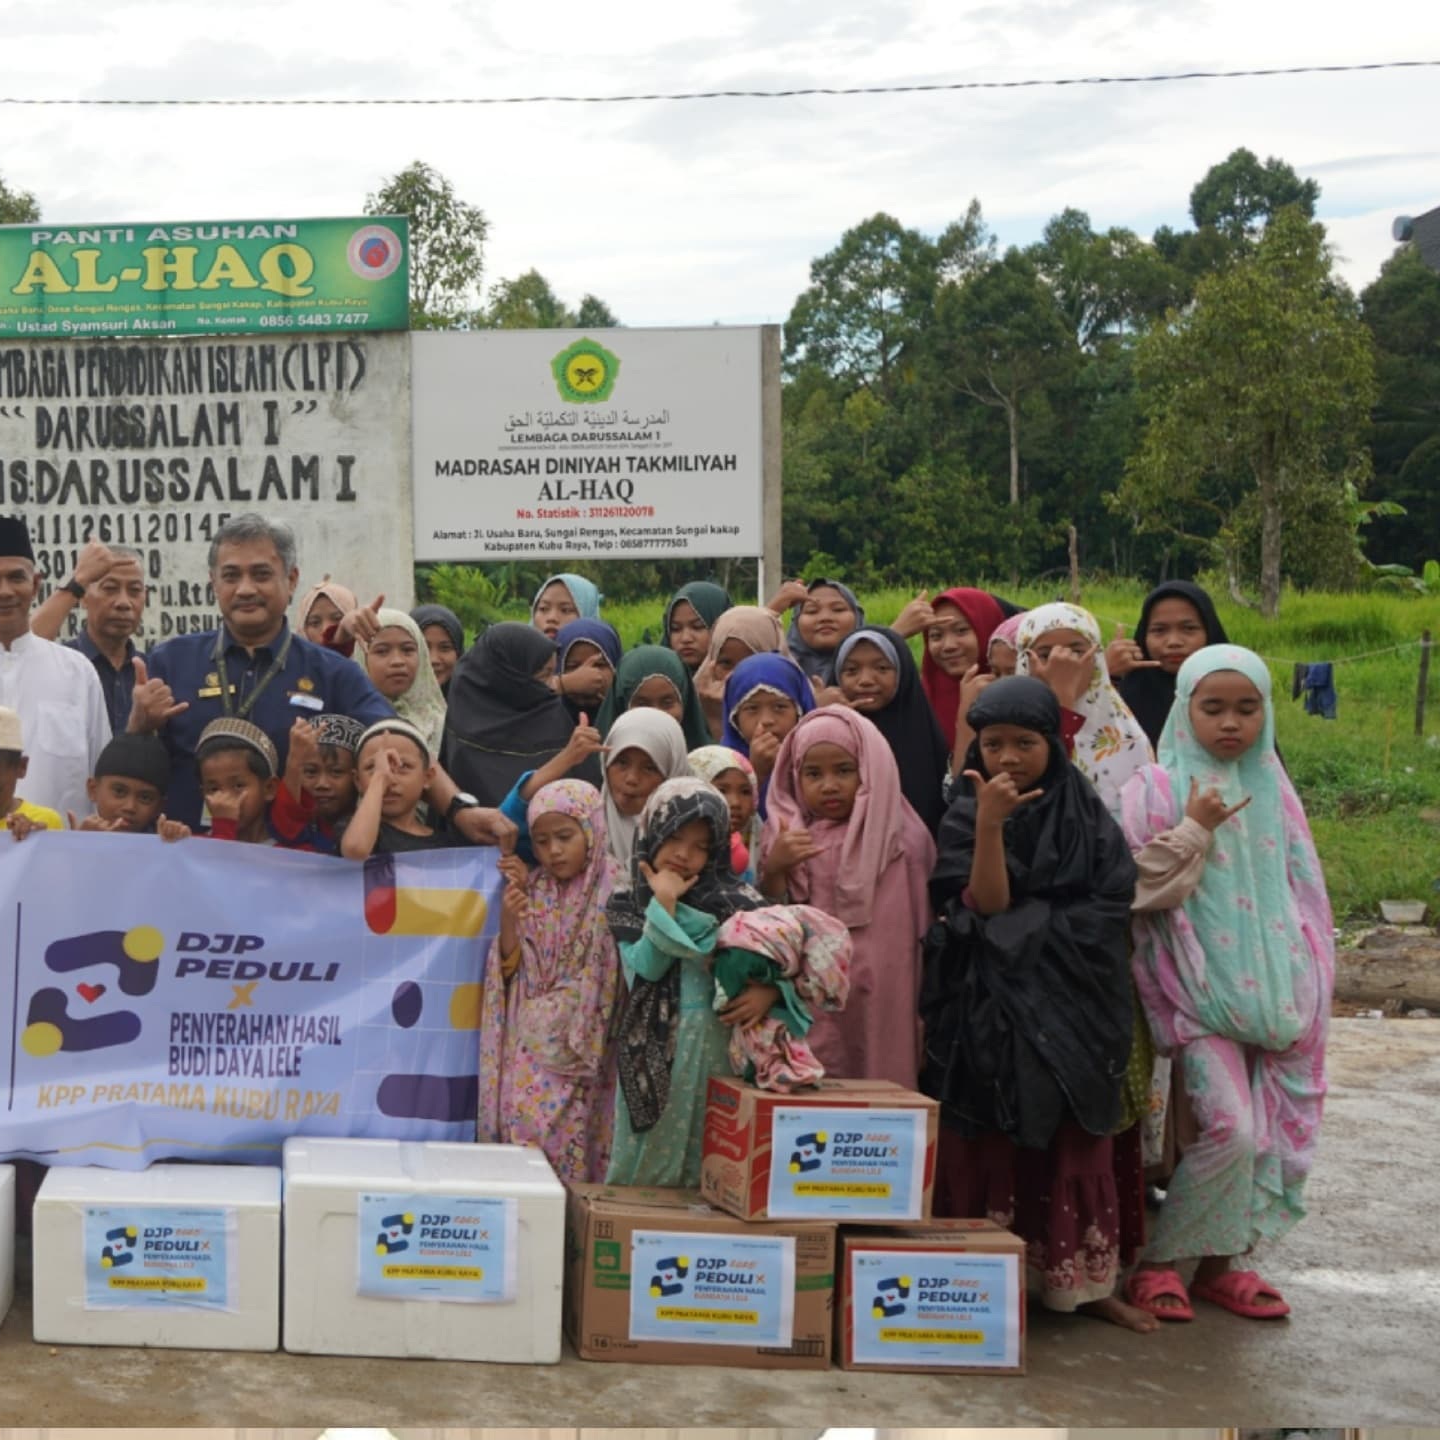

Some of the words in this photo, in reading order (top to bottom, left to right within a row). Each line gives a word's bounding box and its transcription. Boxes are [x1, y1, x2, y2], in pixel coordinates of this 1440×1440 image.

[32, 230, 133, 245] PANTI
[148, 224, 297, 241] ASUHAN
[11, 244, 315, 297] AL-HAQ
[17, 321, 57, 333] Ustad
[62, 320, 127, 332] Syamsuri
[132, 319, 176, 330] Aksan
[260, 315, 293, 327] 0856
[297, 314, 331, 326] 5483
[336, 313, 369, 325] 7477
[74, 346, 202, 396] PENDIDIKAN
[208, 344, 276, 392] ISLAM
[511, 432, 568, 443] LEMBAGA
[572, 432, 652, 442] DARUSSALAM
[435, 458, 539, 477] MADRASAH
[546, 456, 620, 475] DINIYAH
[626, 454, 736, 473] TAKMILIYAH
[538, 478, 634, 503] AL-HAQ
[517, 509, 533, 519] No.
[537, 508, 579, 519] Statistik
[433, 530, 468, 540] Alamat
[487, 528, 515, 539] Usaha
[545, 527, 576, 539] Sungai
[620, 526, 673, 537] Kecamatan
[675, 525, 708, 537] Sungai
[711, 524, 740, 536] kakap
[484, 541, 536, 552] Kabupaten
[176, 932, 264, 954] DJP
[175, 958, 341, 982] PEDULI
[169, 1012, 289, 1046] PENYERAHAN
[291, 1015, 342, 1045] HASIL
[268, 1046, 303, 1078] LELE
[36, 1084, 86, 1109] KPP
[91, 1081, 205, 1112] PRATAMA
[211, 1084, 279, 1122] KUBU
[284, 1087, 342, 1122] RAYA
[833, 1133, 863, 1144] DJP
[832, 1146, 887, 1157] PEDULI
[420, 1214, 450, 1226] DJP
[144, 1228, 173, 1238] DJP
[420, 1228, 477, 1240] PEDULI
[144, 1240, 199, 1251] PEDULI
[696, 1258, 727, 1269] DJP
[695, 1272, 753, 1285] PEDULI
[918, 1278, 949, 1288] DJP
[918, 1292, 977, 1303] PEDULI
